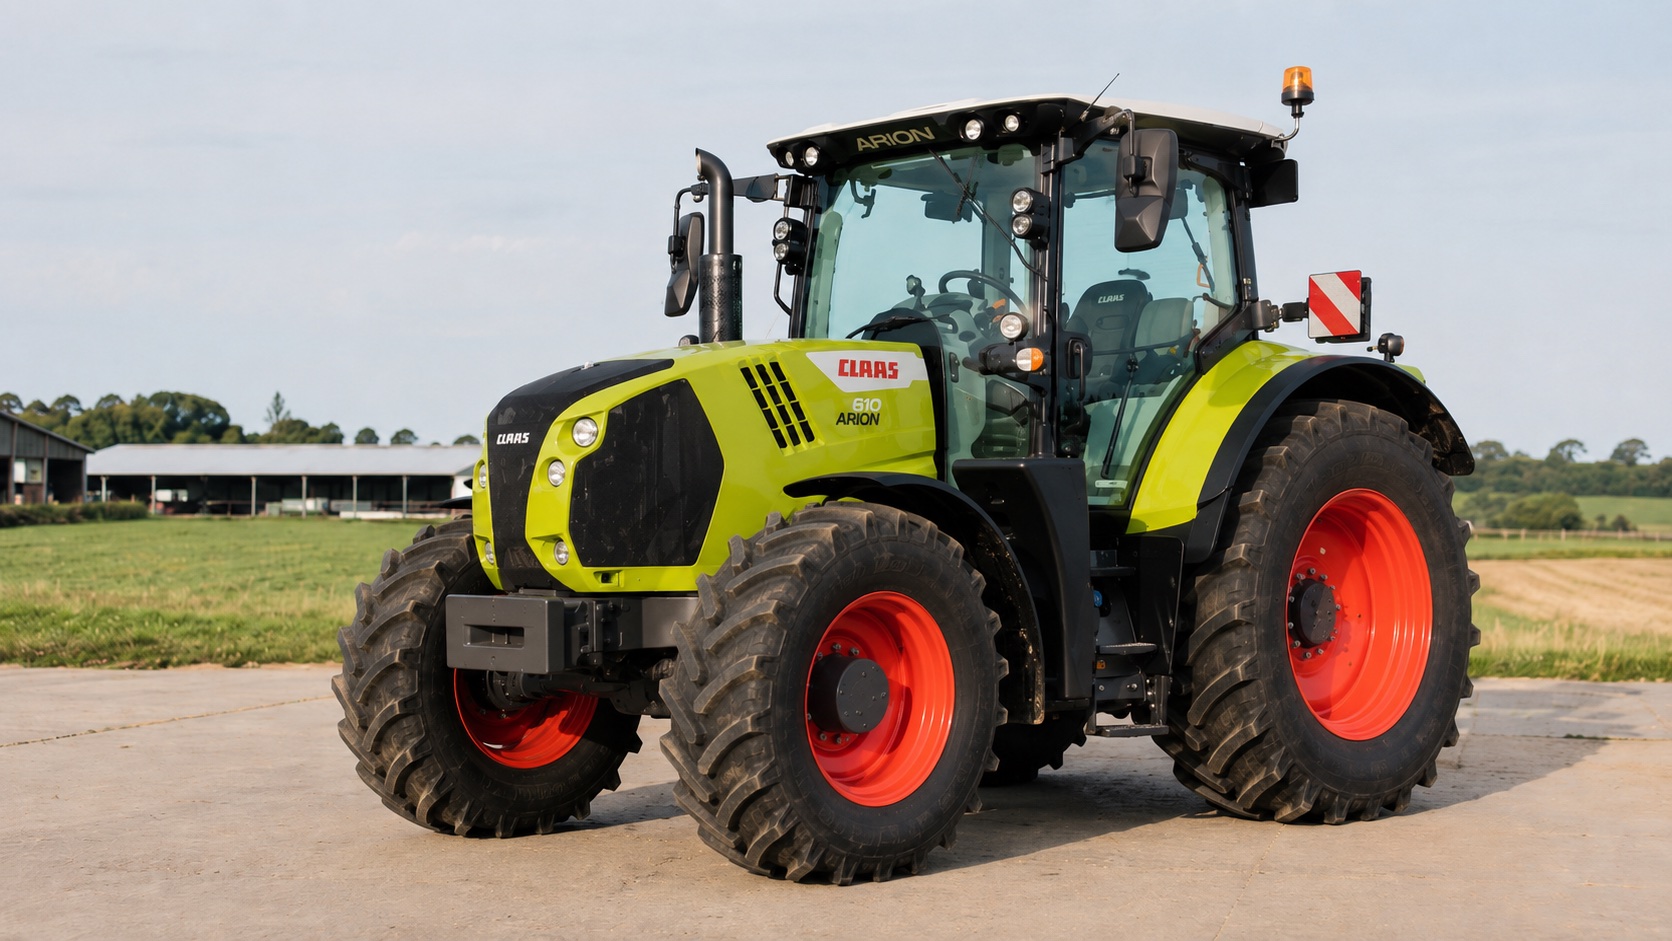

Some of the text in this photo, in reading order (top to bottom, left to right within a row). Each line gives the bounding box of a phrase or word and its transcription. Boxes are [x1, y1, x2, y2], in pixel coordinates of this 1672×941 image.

[857, 126, 936, 151] ARION
[1097, 294, 1125, 304] CLAAS
[838, 359, 899, 379] CLAAS
[852, 397, 882, 412] 610
[836, 412, 880, 425] ARION
[496, 432, 530, 445] CLAAS
